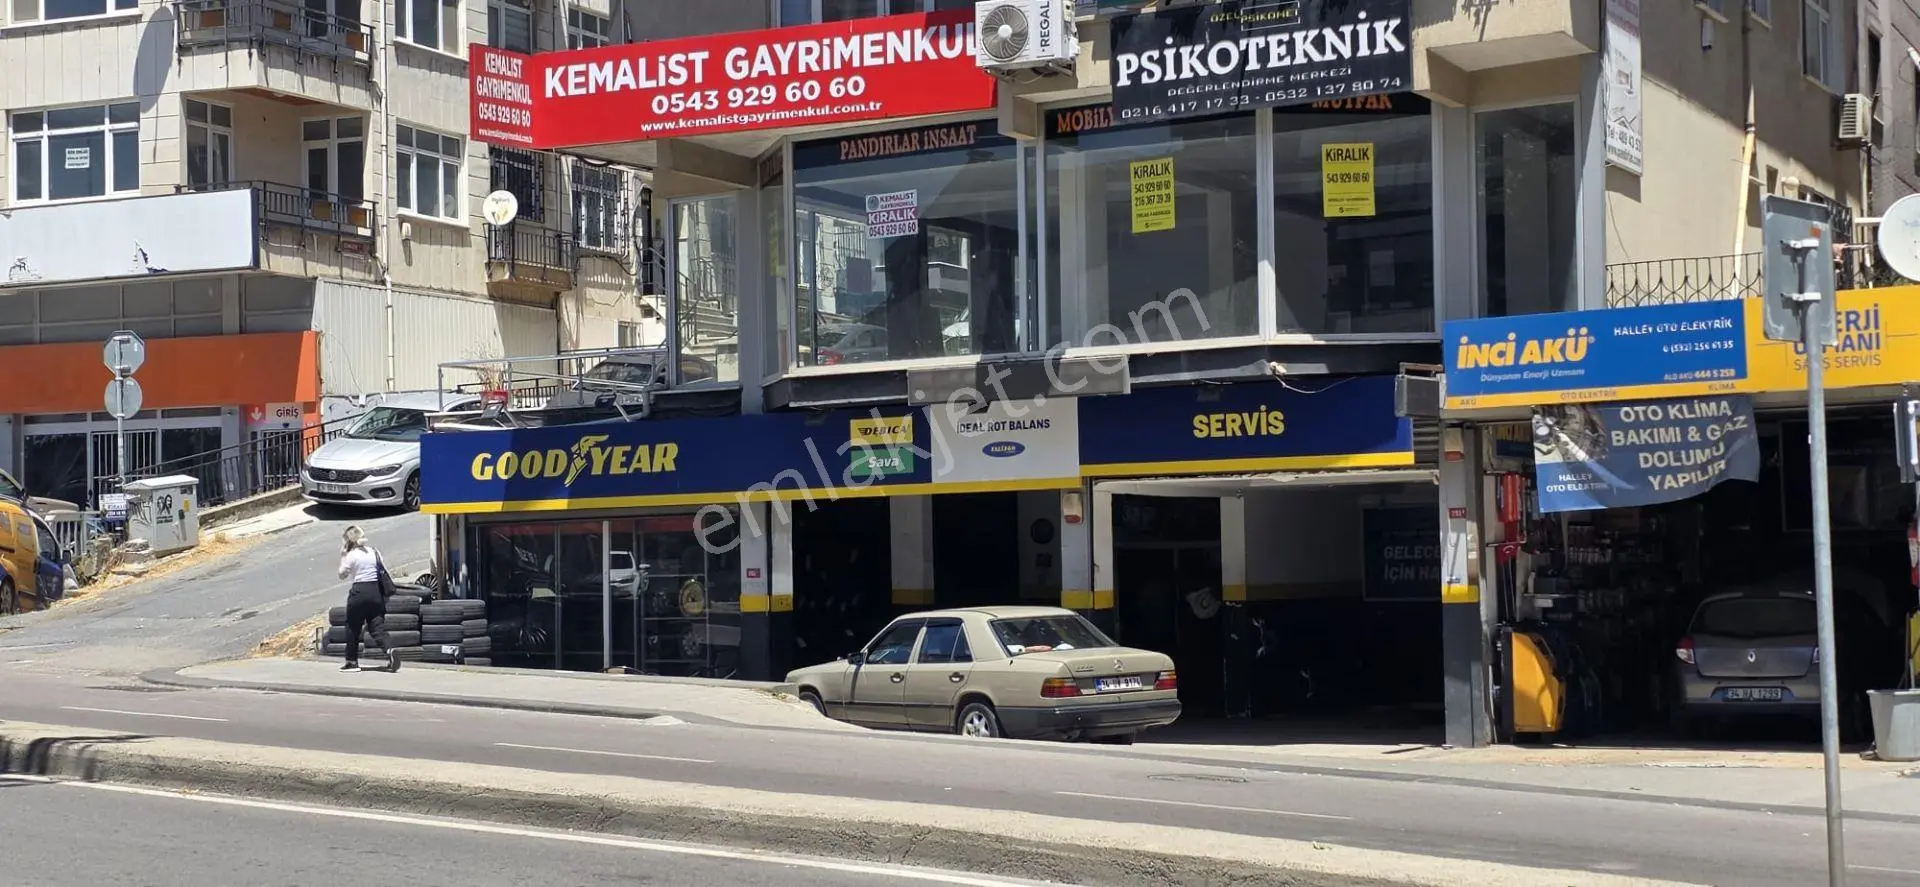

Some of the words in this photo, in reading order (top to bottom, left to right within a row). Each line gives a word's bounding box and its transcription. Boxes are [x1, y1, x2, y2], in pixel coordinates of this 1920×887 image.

[1040, 0, 1050, 47] REGAL
[1117, 10, 1405, 87] PSİKOTEKNİK
[1290, 67, 1352, 82] MERKEZİ
[651, 90, 719, 115] 0543
[727, 85, 777, 108] 929
[785, 79, 821, 102] 60
[829, 75, 865, 98] 60
[1121, 105, 1162, 119] 0216
[1168, 101, 1198, 113] 417
[1206, 98, 1223, 109] 17
[1229, 95, 1250, 106] 33
[1265, 88, 1307, 102] 0532
[1316, 84, 1345, 96] 137
[1352, 81, 1373, 91] 80
[1380, 77, 1401, 88] 74
[478, 102, 496, 121] 0543
[497, 105, 510, 124] 929
[511, 108, 520, 126] 60
[521, 110, 530, 128] 60
[641, 101, 882, 132] www.kemalistgayrimenkul.com.tr
[840, 132, 920, 160] PANDIRLAR
[1134, 183, 1144, 193] 543
[1145, 182, 1155, 193] 929
[1326, 173, 1338, 184] 543
[869, 225, 885, 237] 0543
[886, 223, 897, 235] 929
[907, 221, 917, 232] 60
[1656, 322, 1677, 333] OTO
[1456, 331, 1516, 369] İNCİ
[1518, 326, 1588, 365] AKÜ
[1694, 370, 1711, 378] 444
[276, 406, 299, 419] GİRİŞ
[1193, 404, 1285, 439] SERVİS
[1619, 405, 1663, 422] OTO
[1667, 400, 1732, 420] KLİMA
[987, 420, 1007, 432] ROT
[1009, 419, 1051, 431] BALANS
[1611, 427, 1682, 446] BAKIMI
[1687, 426, 1702, 442] &
[1706, 416, 1748, 441] GAZ
[868, 456, 899, 468] Sava
[1638, 441, 1725, 468] DOLUMU
[1558, 473, 1593, 482] HALLEY
[1648, 459, 1726, 491] YAPILIR
[1546, 484, 1565, 493] OTO
